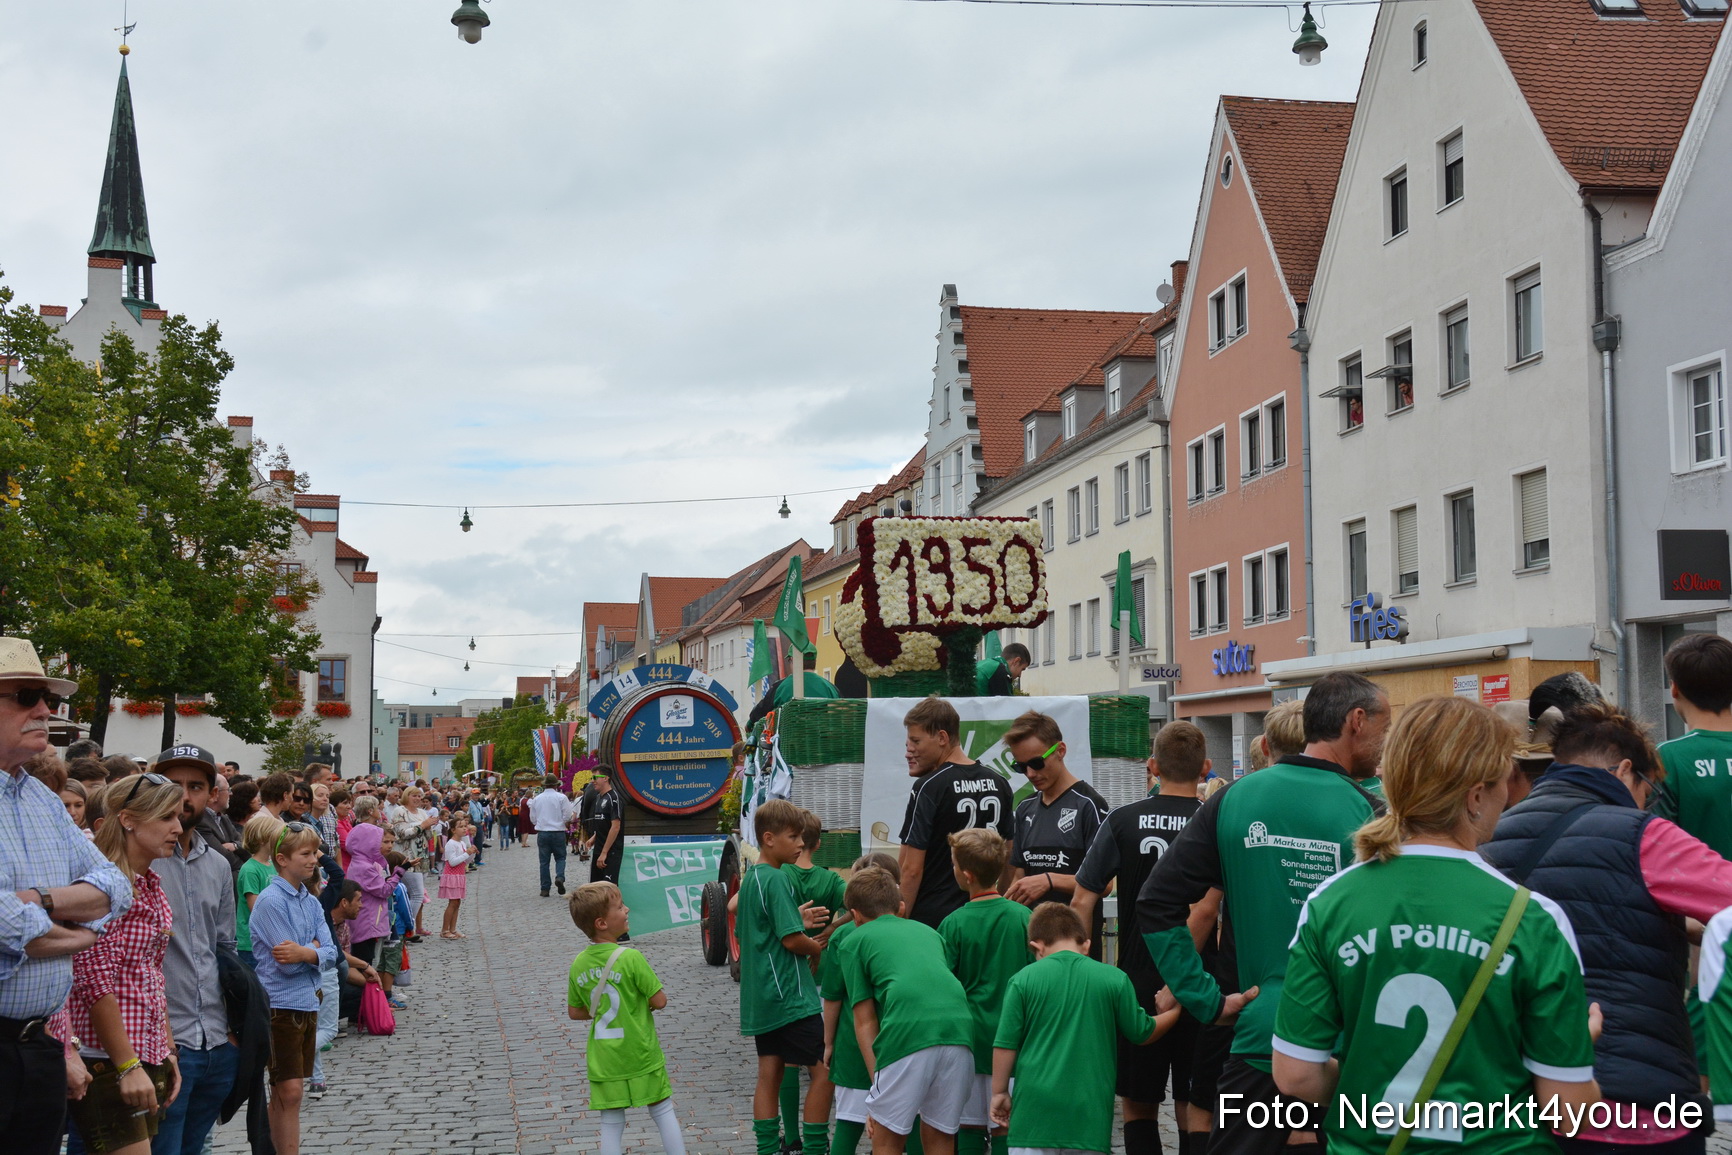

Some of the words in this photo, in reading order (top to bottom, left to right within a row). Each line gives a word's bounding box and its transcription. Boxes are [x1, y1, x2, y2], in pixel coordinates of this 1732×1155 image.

[889, 533, 1040, 624] 1950
[1672, 571, 1722, 592] s.Oliver
[648, 666, 673, 679] 444
[618, 674, 633, 689] 14
[599, 692, 618, 713] 1574
[630, 720, 646, 742] 1574
[703, 718, 723, 738] 2018
[656, 731, 683, 745] 444
[684, 735, 706, 744] Jahre
[172, 746, 199, 757] 1516
[634, 753, 658, 761] FEIERN
[660, 752, 669, 760] SIE
[699, 750, 706, 758] IN
[652, 763, 707, 772] Brautradition
[1694, 758, 1716, 777] SV
[649, 778, 663, 791] 14
[664, 781, 711, 790] Generationen
[675, 773, 684, 781] in
[953, 778, 999, 794] GAMMERL
[642, 789, 659, 803] HOPFEN
[658, 797, 670, 806] UND
[682, 797, 696, 806] GOTT
[956, 795, 1001, 832] 23
[1273, 837, 1306, 849] Markus
[1308, 841, 1336, 853] Münch
[1280, 858, 1334, 873] Sonnenschutz
[1304, 852, 1333, 863] Fenster
[1295, 870, 1330, 881] Haustüre
[1288, 878, 1319, 890] Zimmert
[1337, 927, 1378, 967] SV
[1390, 923, 1515, 976] Pölling
[576, 971, 589, 987] SV
[589, 966, 622, 984] Pöng
[590, 983, 625, 1040] 2
[1374, 972, 1463, 1142] 2
